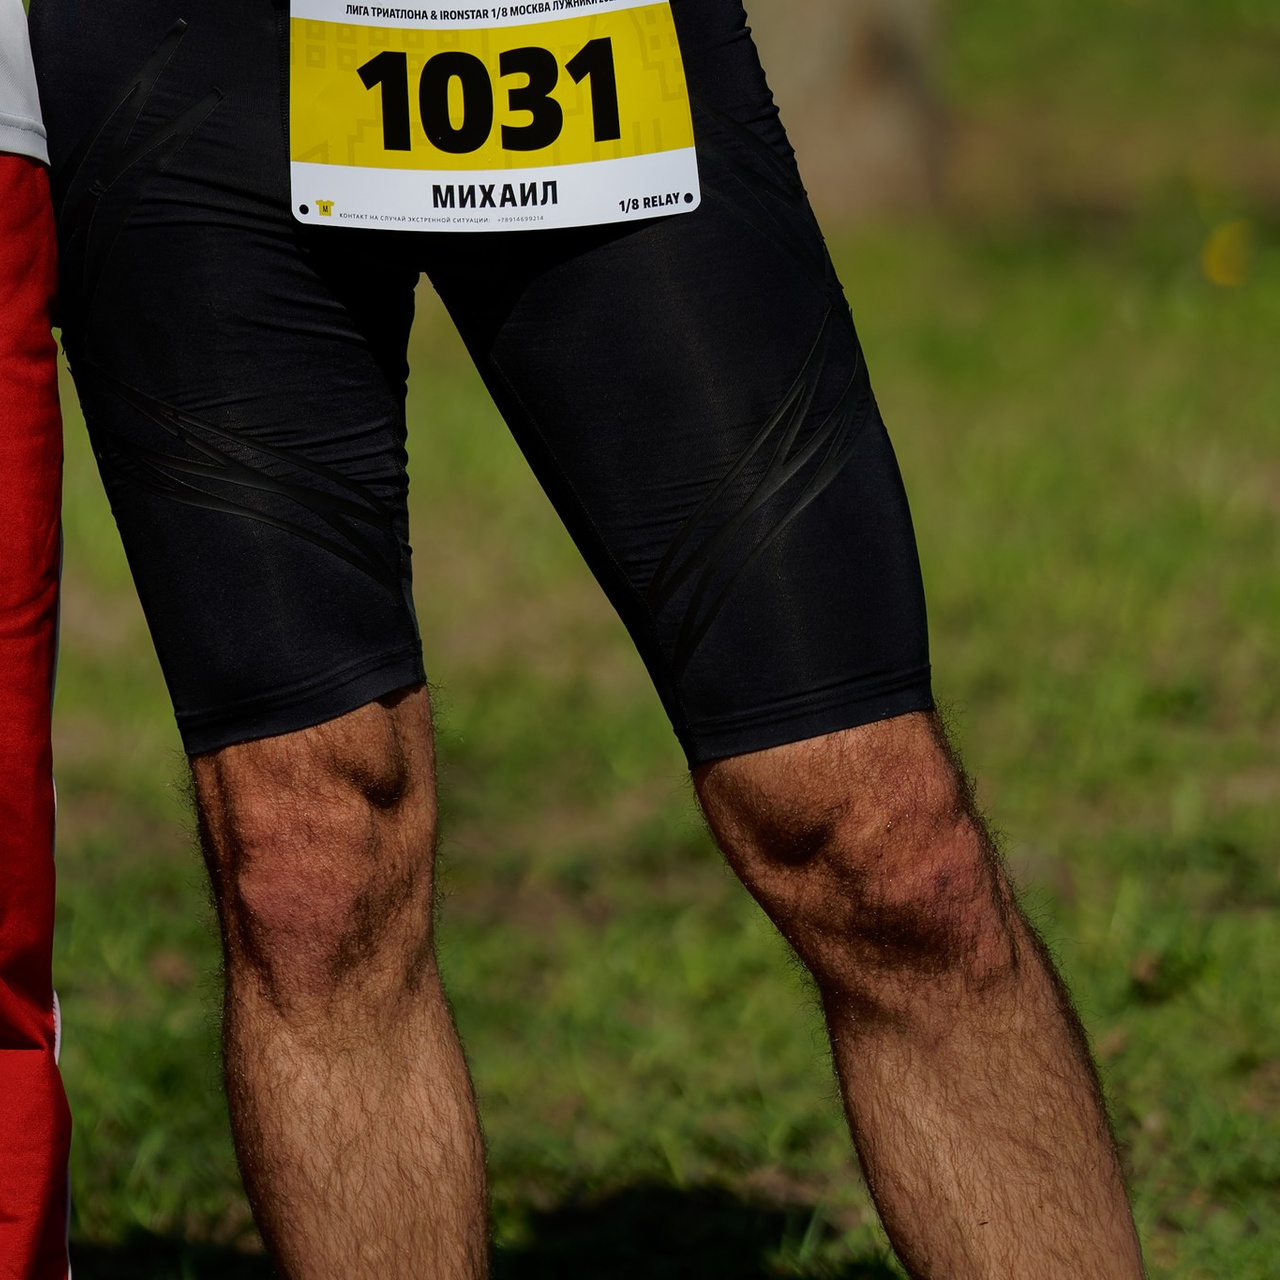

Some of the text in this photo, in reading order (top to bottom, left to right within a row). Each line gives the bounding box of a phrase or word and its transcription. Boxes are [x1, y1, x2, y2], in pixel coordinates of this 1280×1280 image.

[346, 4, 368, 16] ЛИГА
[371, 5, 428, 20] ТРИАТЛОНА
[430, 11, 438, 20] &
[439, 9, 489, 21] IRONSTAR
[490, 6, 508, 19] 1/8
[509, 2, 551, 17] МОСКВА
[356, 36, 621, 154] 1031
[432, 180, 558, 208] МИХАИЛ
[619, 192, 680, 213] 1/8 RELAY
[339, 212, 368, 220] КОНТАКТ
